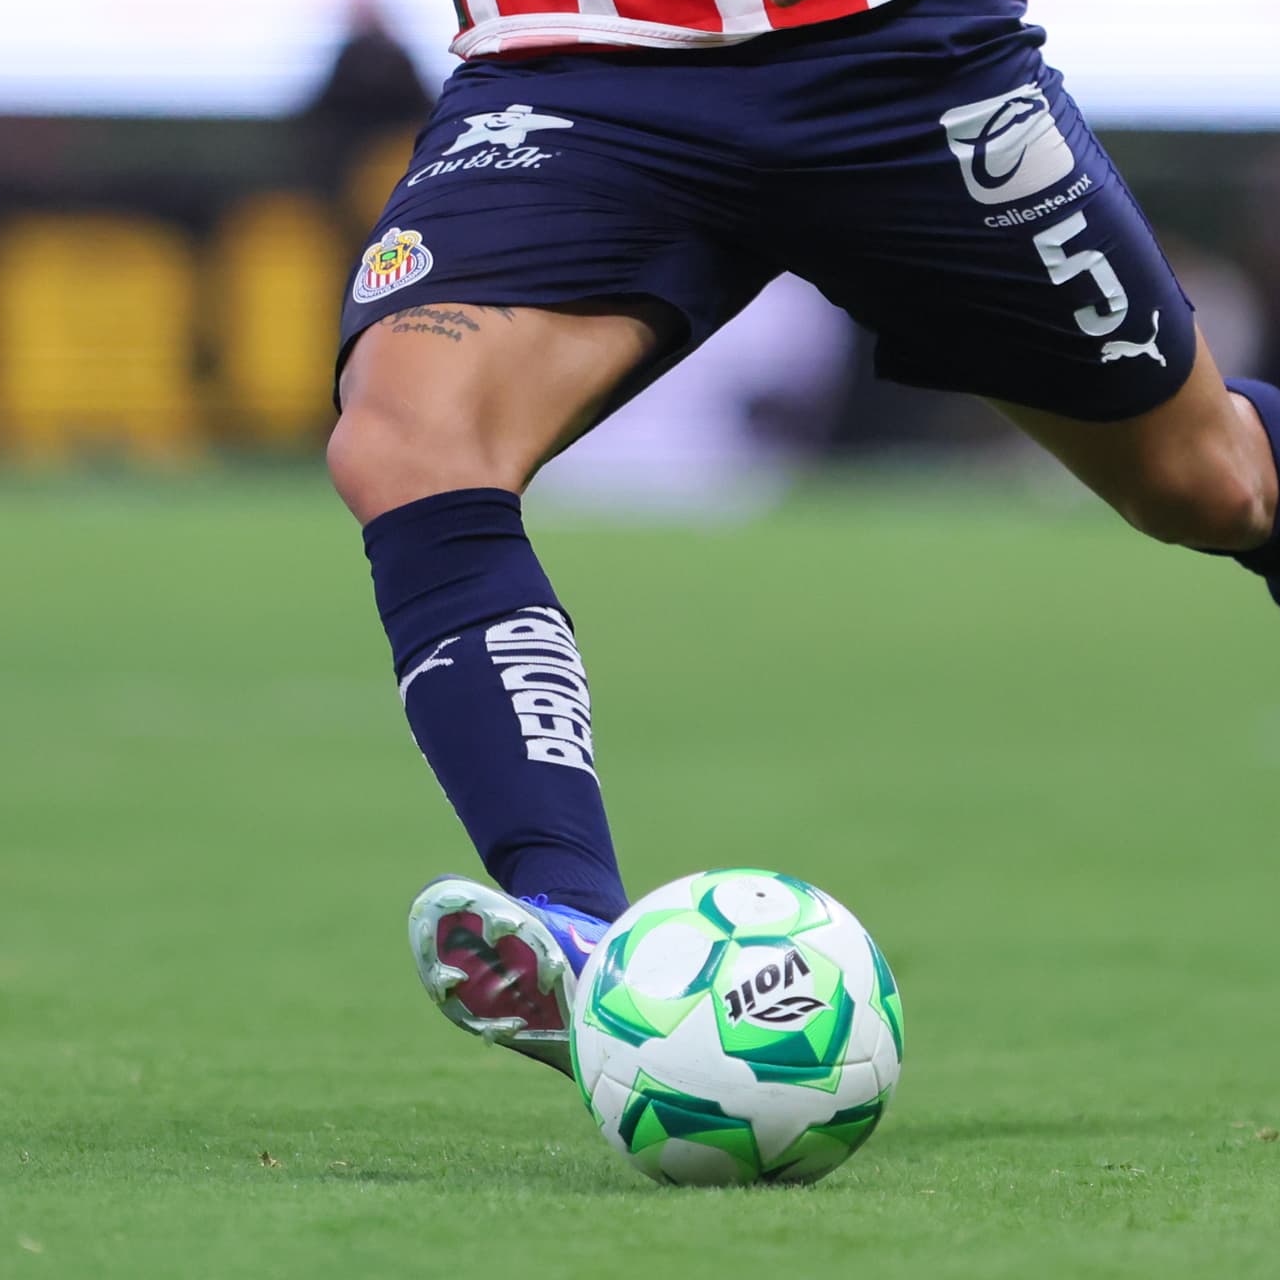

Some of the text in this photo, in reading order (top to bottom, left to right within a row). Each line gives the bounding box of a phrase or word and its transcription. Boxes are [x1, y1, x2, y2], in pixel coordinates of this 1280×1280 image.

[494, 146, 553, 170] Jr.
[983, 173, 1093, 229] caliente.mx
[1031, 209, 1130, 338] 5
